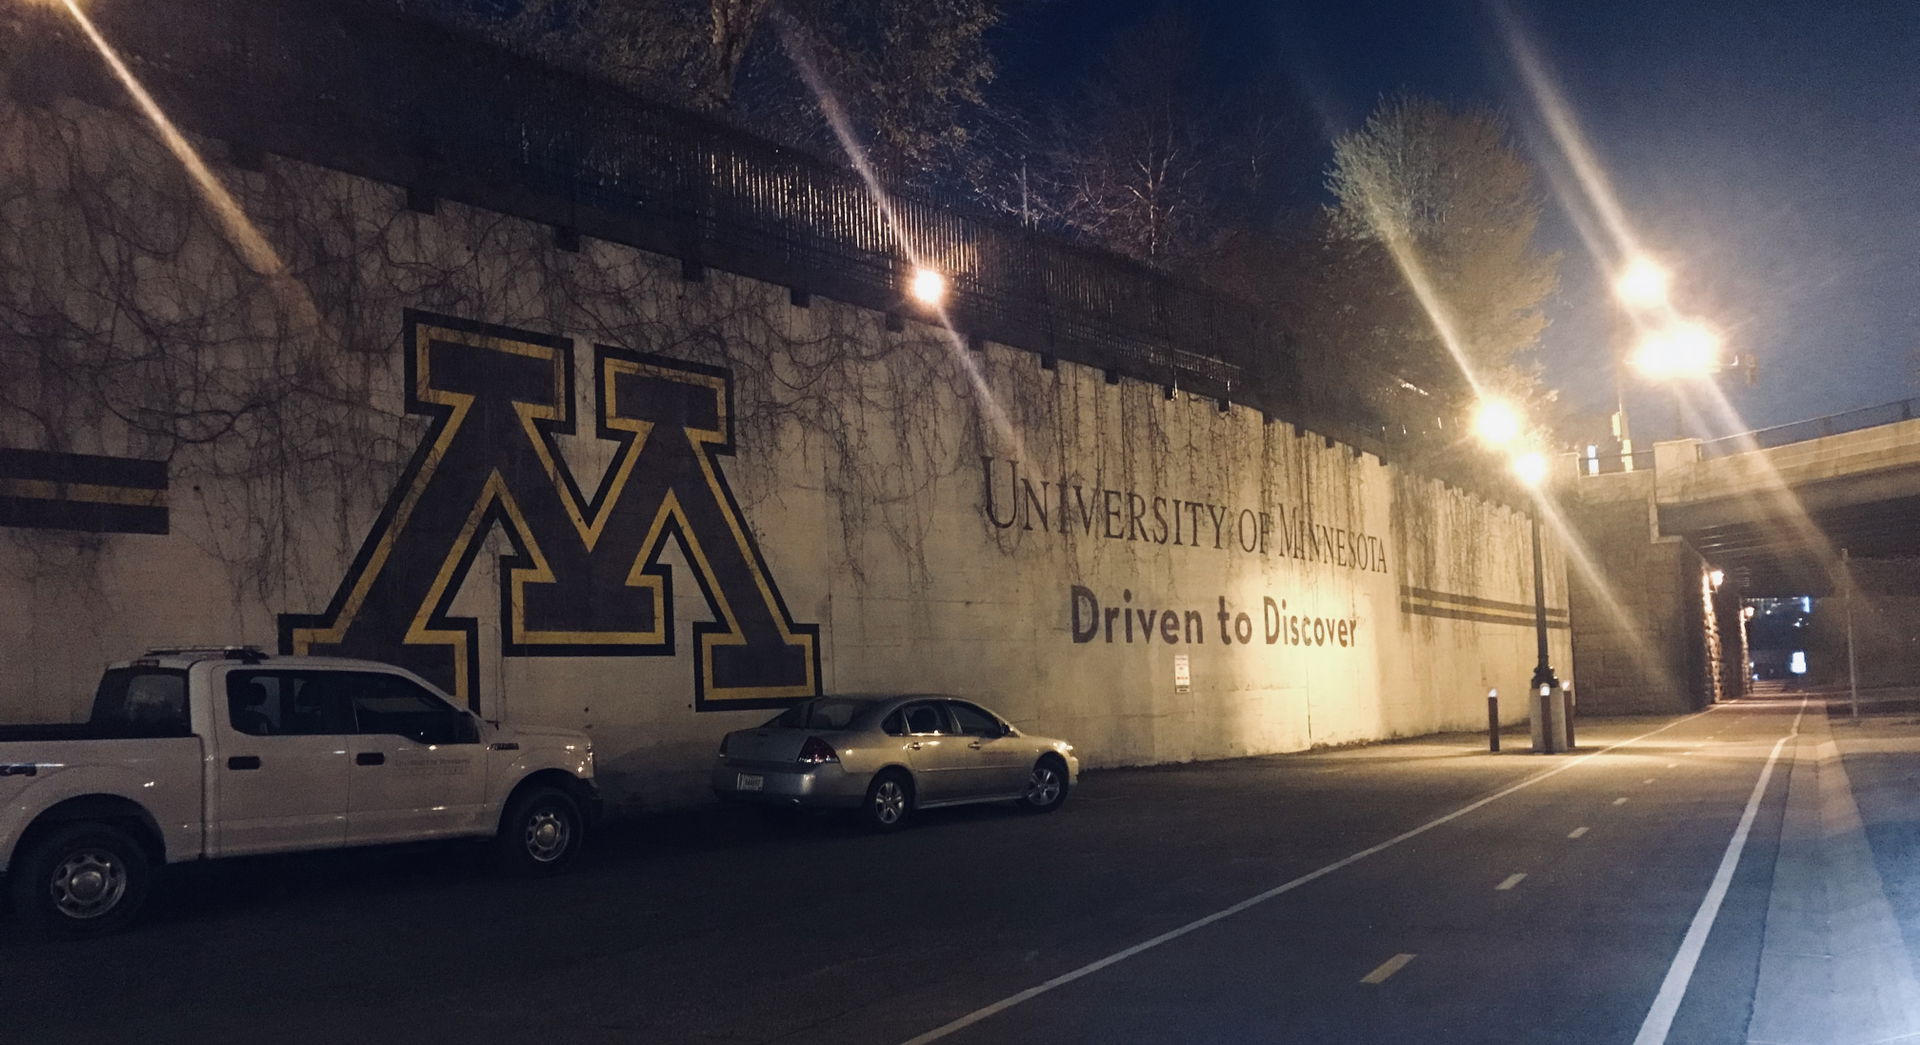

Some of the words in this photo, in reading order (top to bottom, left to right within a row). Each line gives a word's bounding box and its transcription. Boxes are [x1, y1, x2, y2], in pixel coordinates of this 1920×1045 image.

[278, 308, 822, 713] M
[980, 455, 1228, 550] UNIVERSITY
[1238, 508, 1273, 554] OF
[1278, 502, 1389, 574] MINNESOTA
[1070, 584, 1204, 645] Driven
[1217, 595, 1253, 646] to
[1263, 595, 1358, 648] Discover
